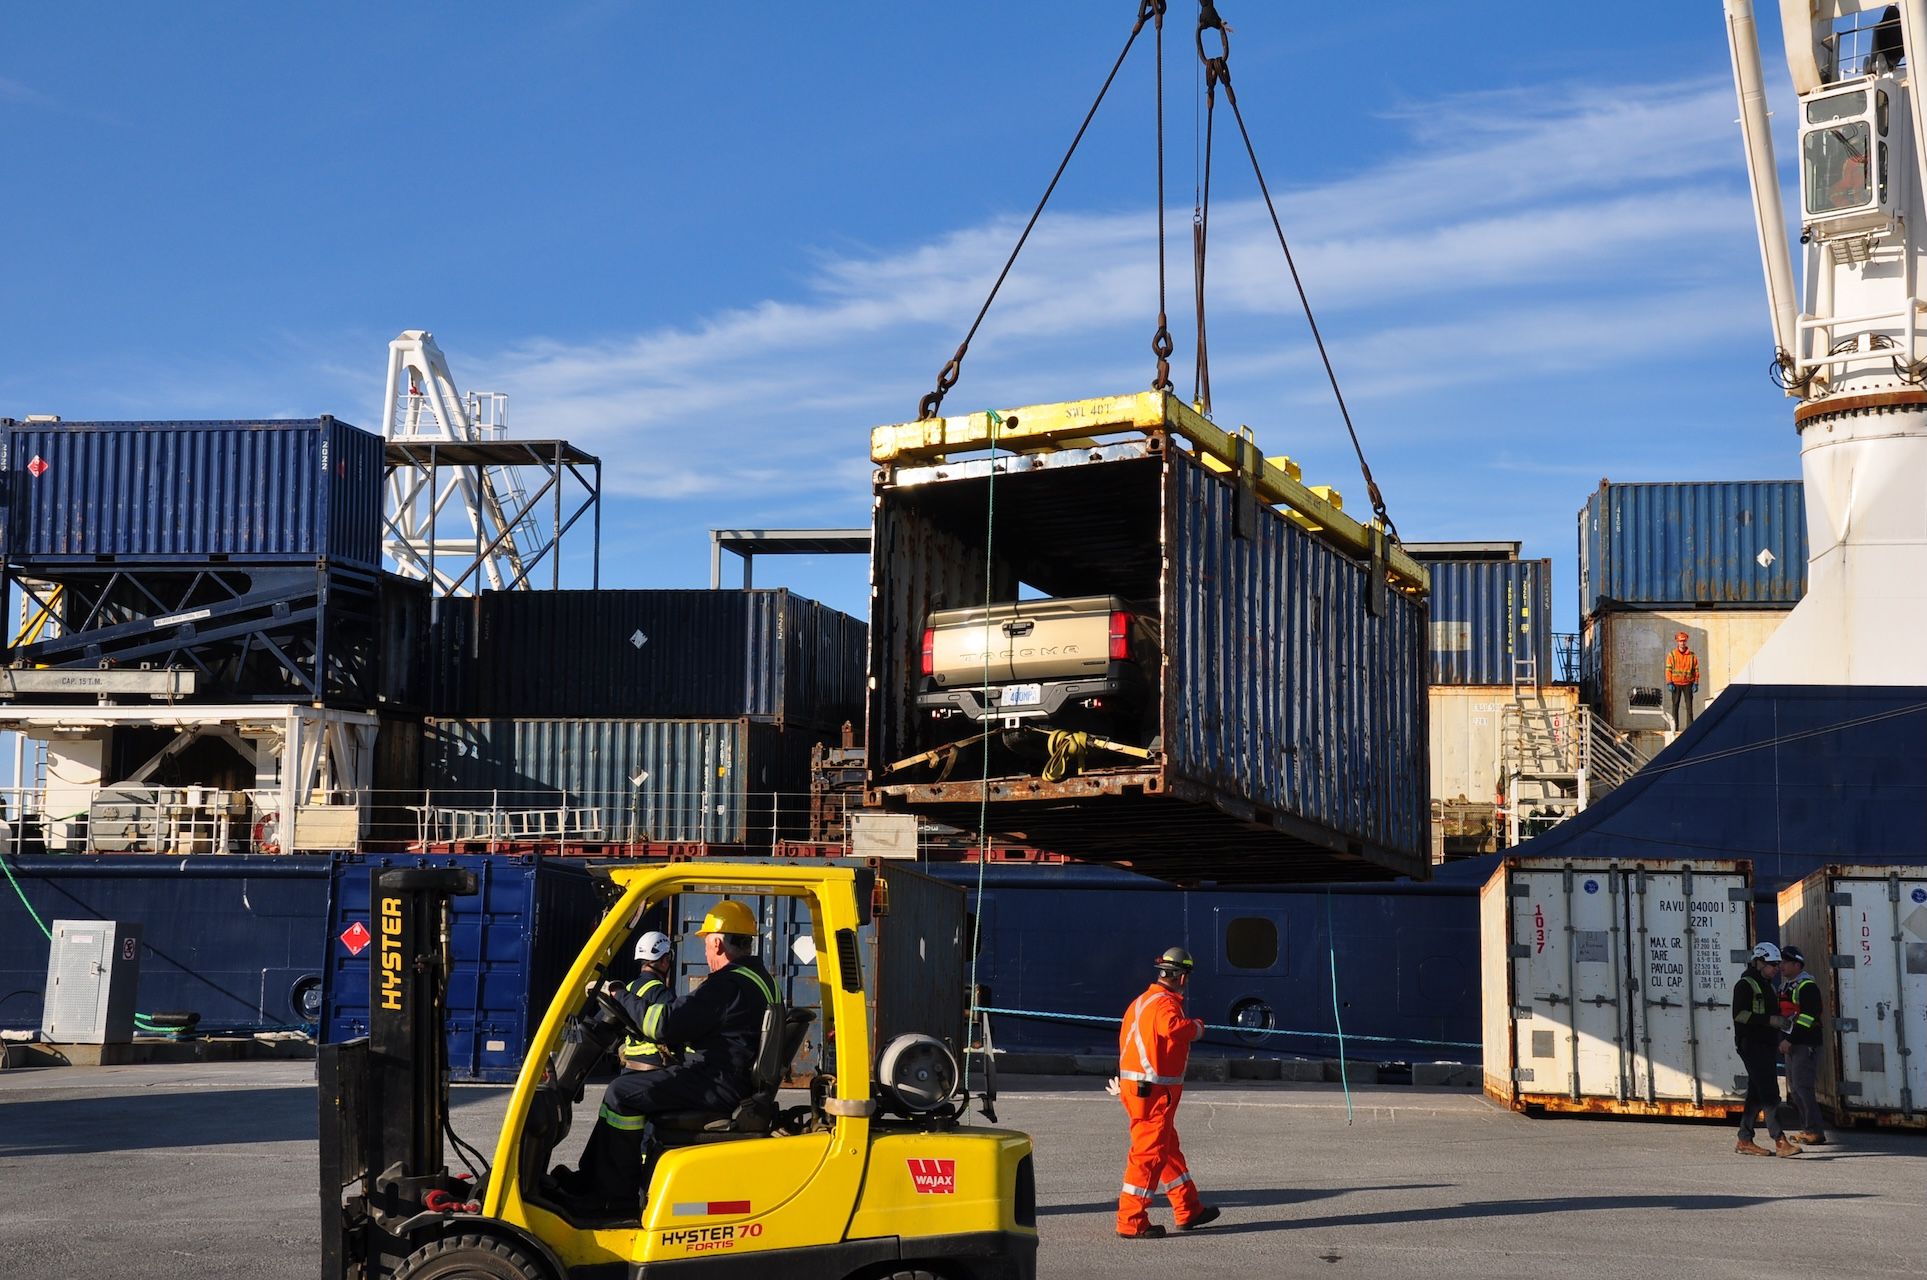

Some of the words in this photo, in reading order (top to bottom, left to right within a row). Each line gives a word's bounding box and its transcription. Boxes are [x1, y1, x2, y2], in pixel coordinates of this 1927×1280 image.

[321, 440, 329, 471] 2022
[960, 645, 1080, 661] TACOMA
[1659, 900, 1685, 912] RAVU
[1690, 901, 1724, 913] 040001
[1730, 902, 1736, 913] 3
[765, 903, 774, 954] 4041
[1535, 903, 1545, 954] 1037
[1691, 916, 1713, 928] 22R1
[1861, 911, 1872, 967] 1052
[381, 897, 402, 1010] HYSTER
[1651, 950, 1669, 961] TARE
[1651, 962, 1684, 975] PAYLOAD
[1651, 976, 1664, 988] CU.
[1667, 977, 1684, 988] CAP.
[915, 1175, 953, 1188] WAJAX
[662, 1226, 734, 1246] HYSTER
[738, 1223, 763, 1238] 70
[686, 1240, 734, 1252] FORTIS
